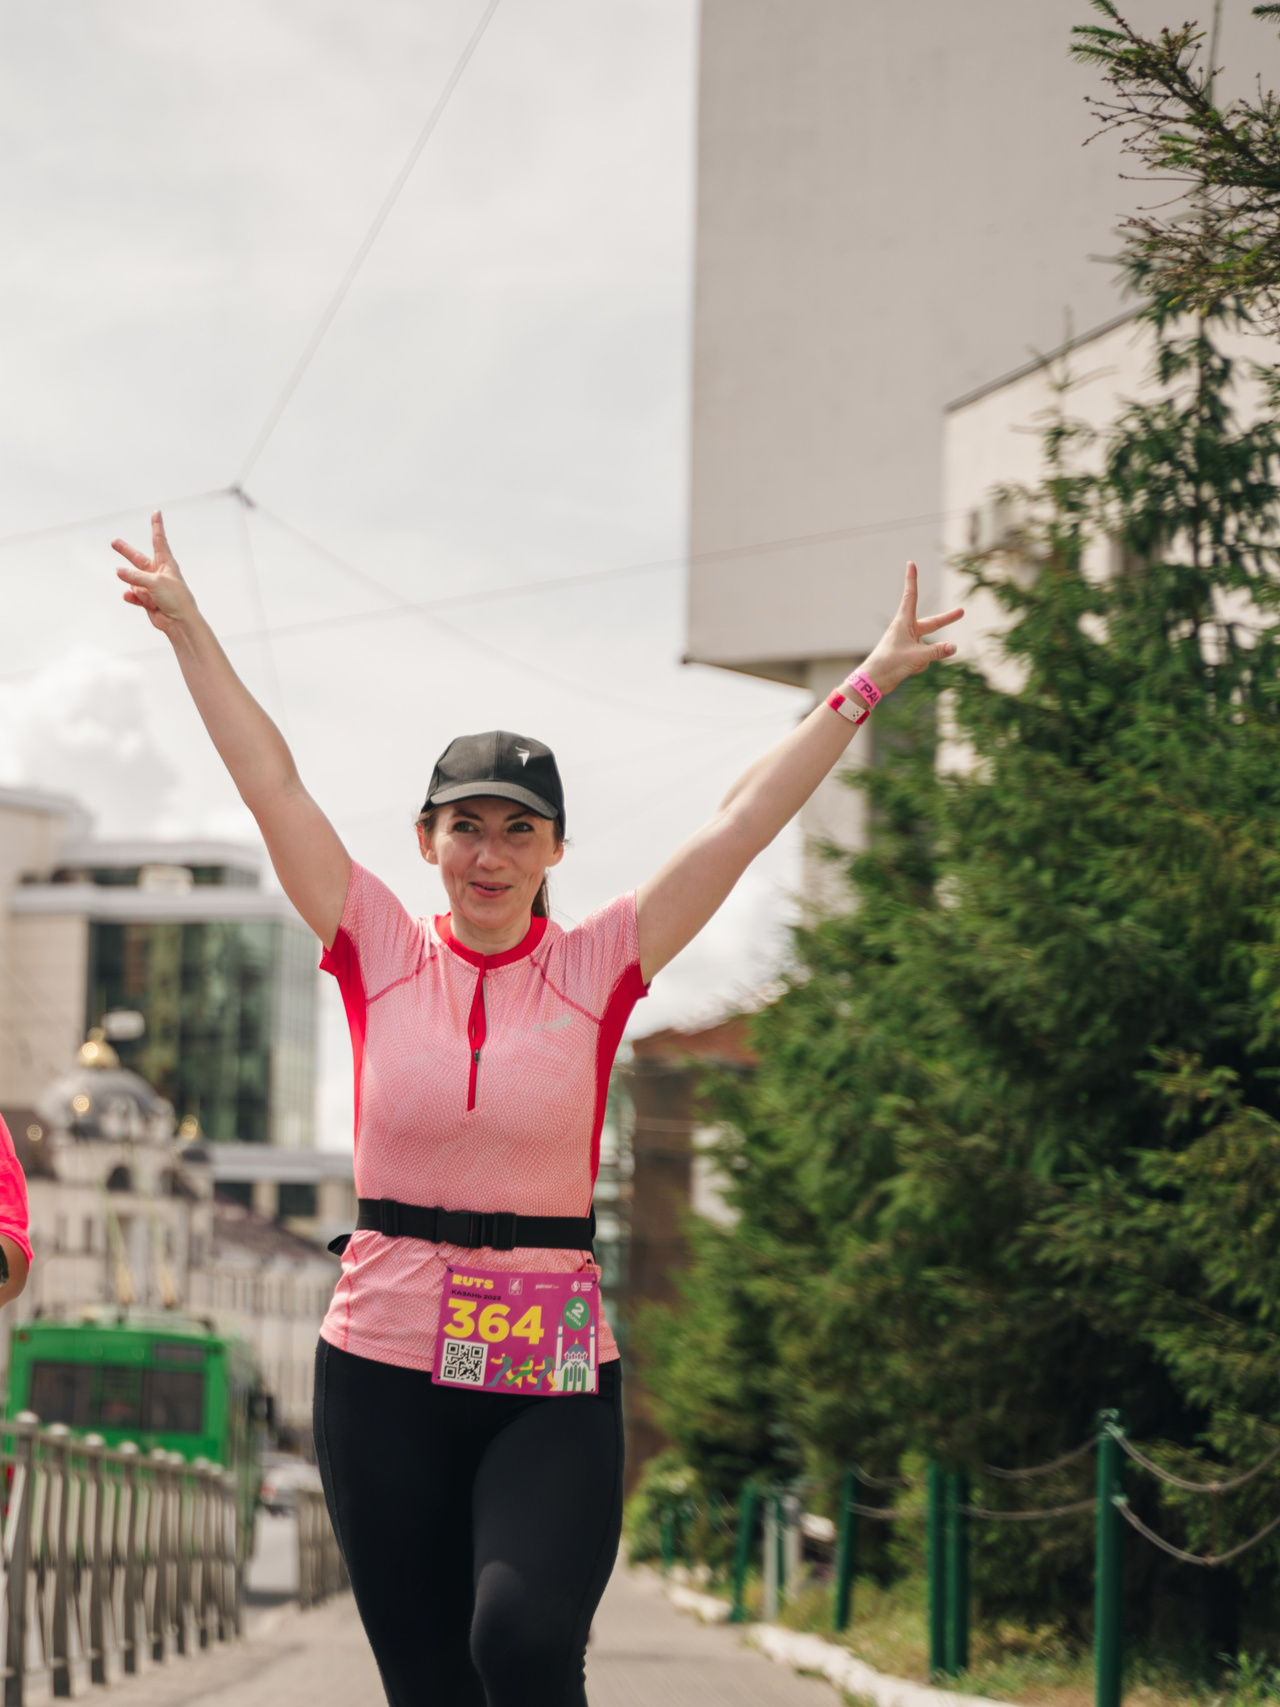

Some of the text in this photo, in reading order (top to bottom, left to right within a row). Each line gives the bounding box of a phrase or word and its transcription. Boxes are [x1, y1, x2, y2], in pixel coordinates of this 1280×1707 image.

[452, 1273, 494, 1290] RUTS
[451, 1289, 482, 1299] КАЗАНЬ
[571, 1303, 585, 1319] 2
[443, 1298, 545, 1345] 364
